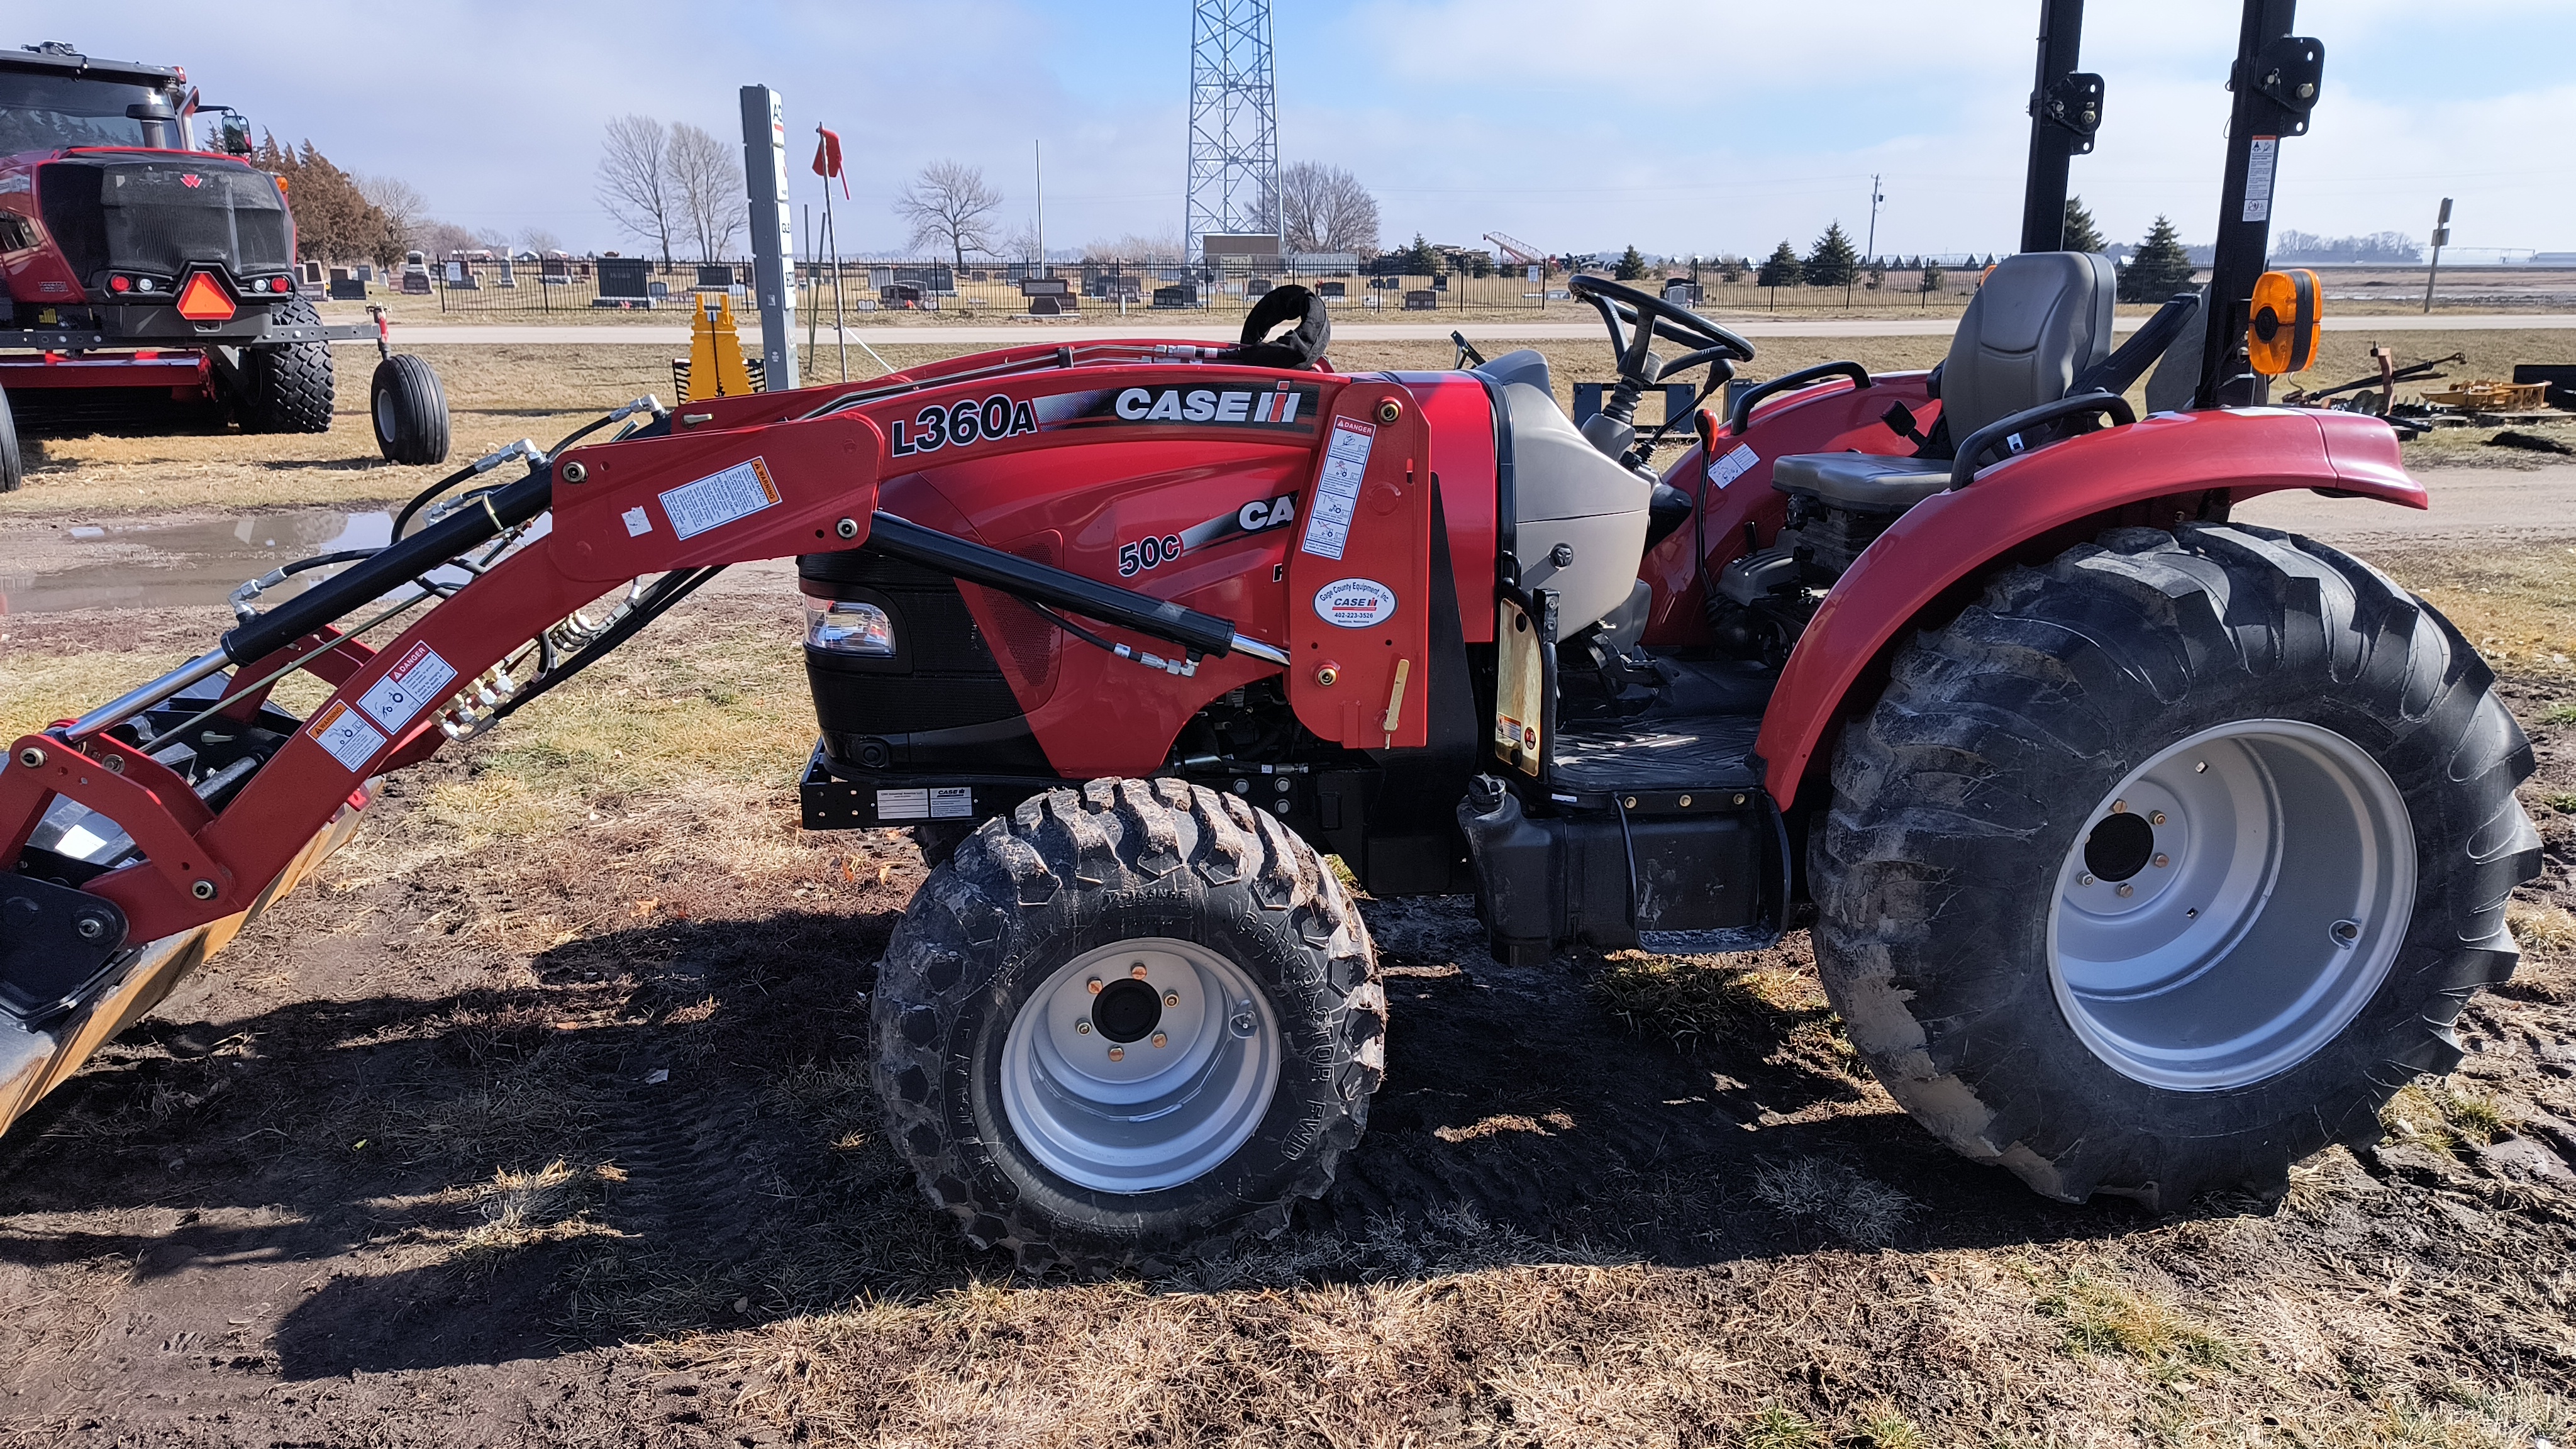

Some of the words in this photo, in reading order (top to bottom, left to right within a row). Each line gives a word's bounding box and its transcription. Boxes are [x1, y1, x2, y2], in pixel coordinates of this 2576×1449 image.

[1115, 388, 1252, 422] CASE
[891, 394, 1038, 458] L360A
[1344, 422, 1372, 434] DANGER
[758, 470, 775, 499] WARNING
[1239, 496, 1295, 531] CA
[1118, 535, 1180, 577] 50C
[1319, 591, 1334, 601] Gage
[1333, 583, 1352, 593] County
[1380, 592, 1389, 602] Inc.
[399, 647, 426, 673] DANGER
[321, 707, 343, 729] WARNING
[1280, 1099, 1326, 1161] FWD
